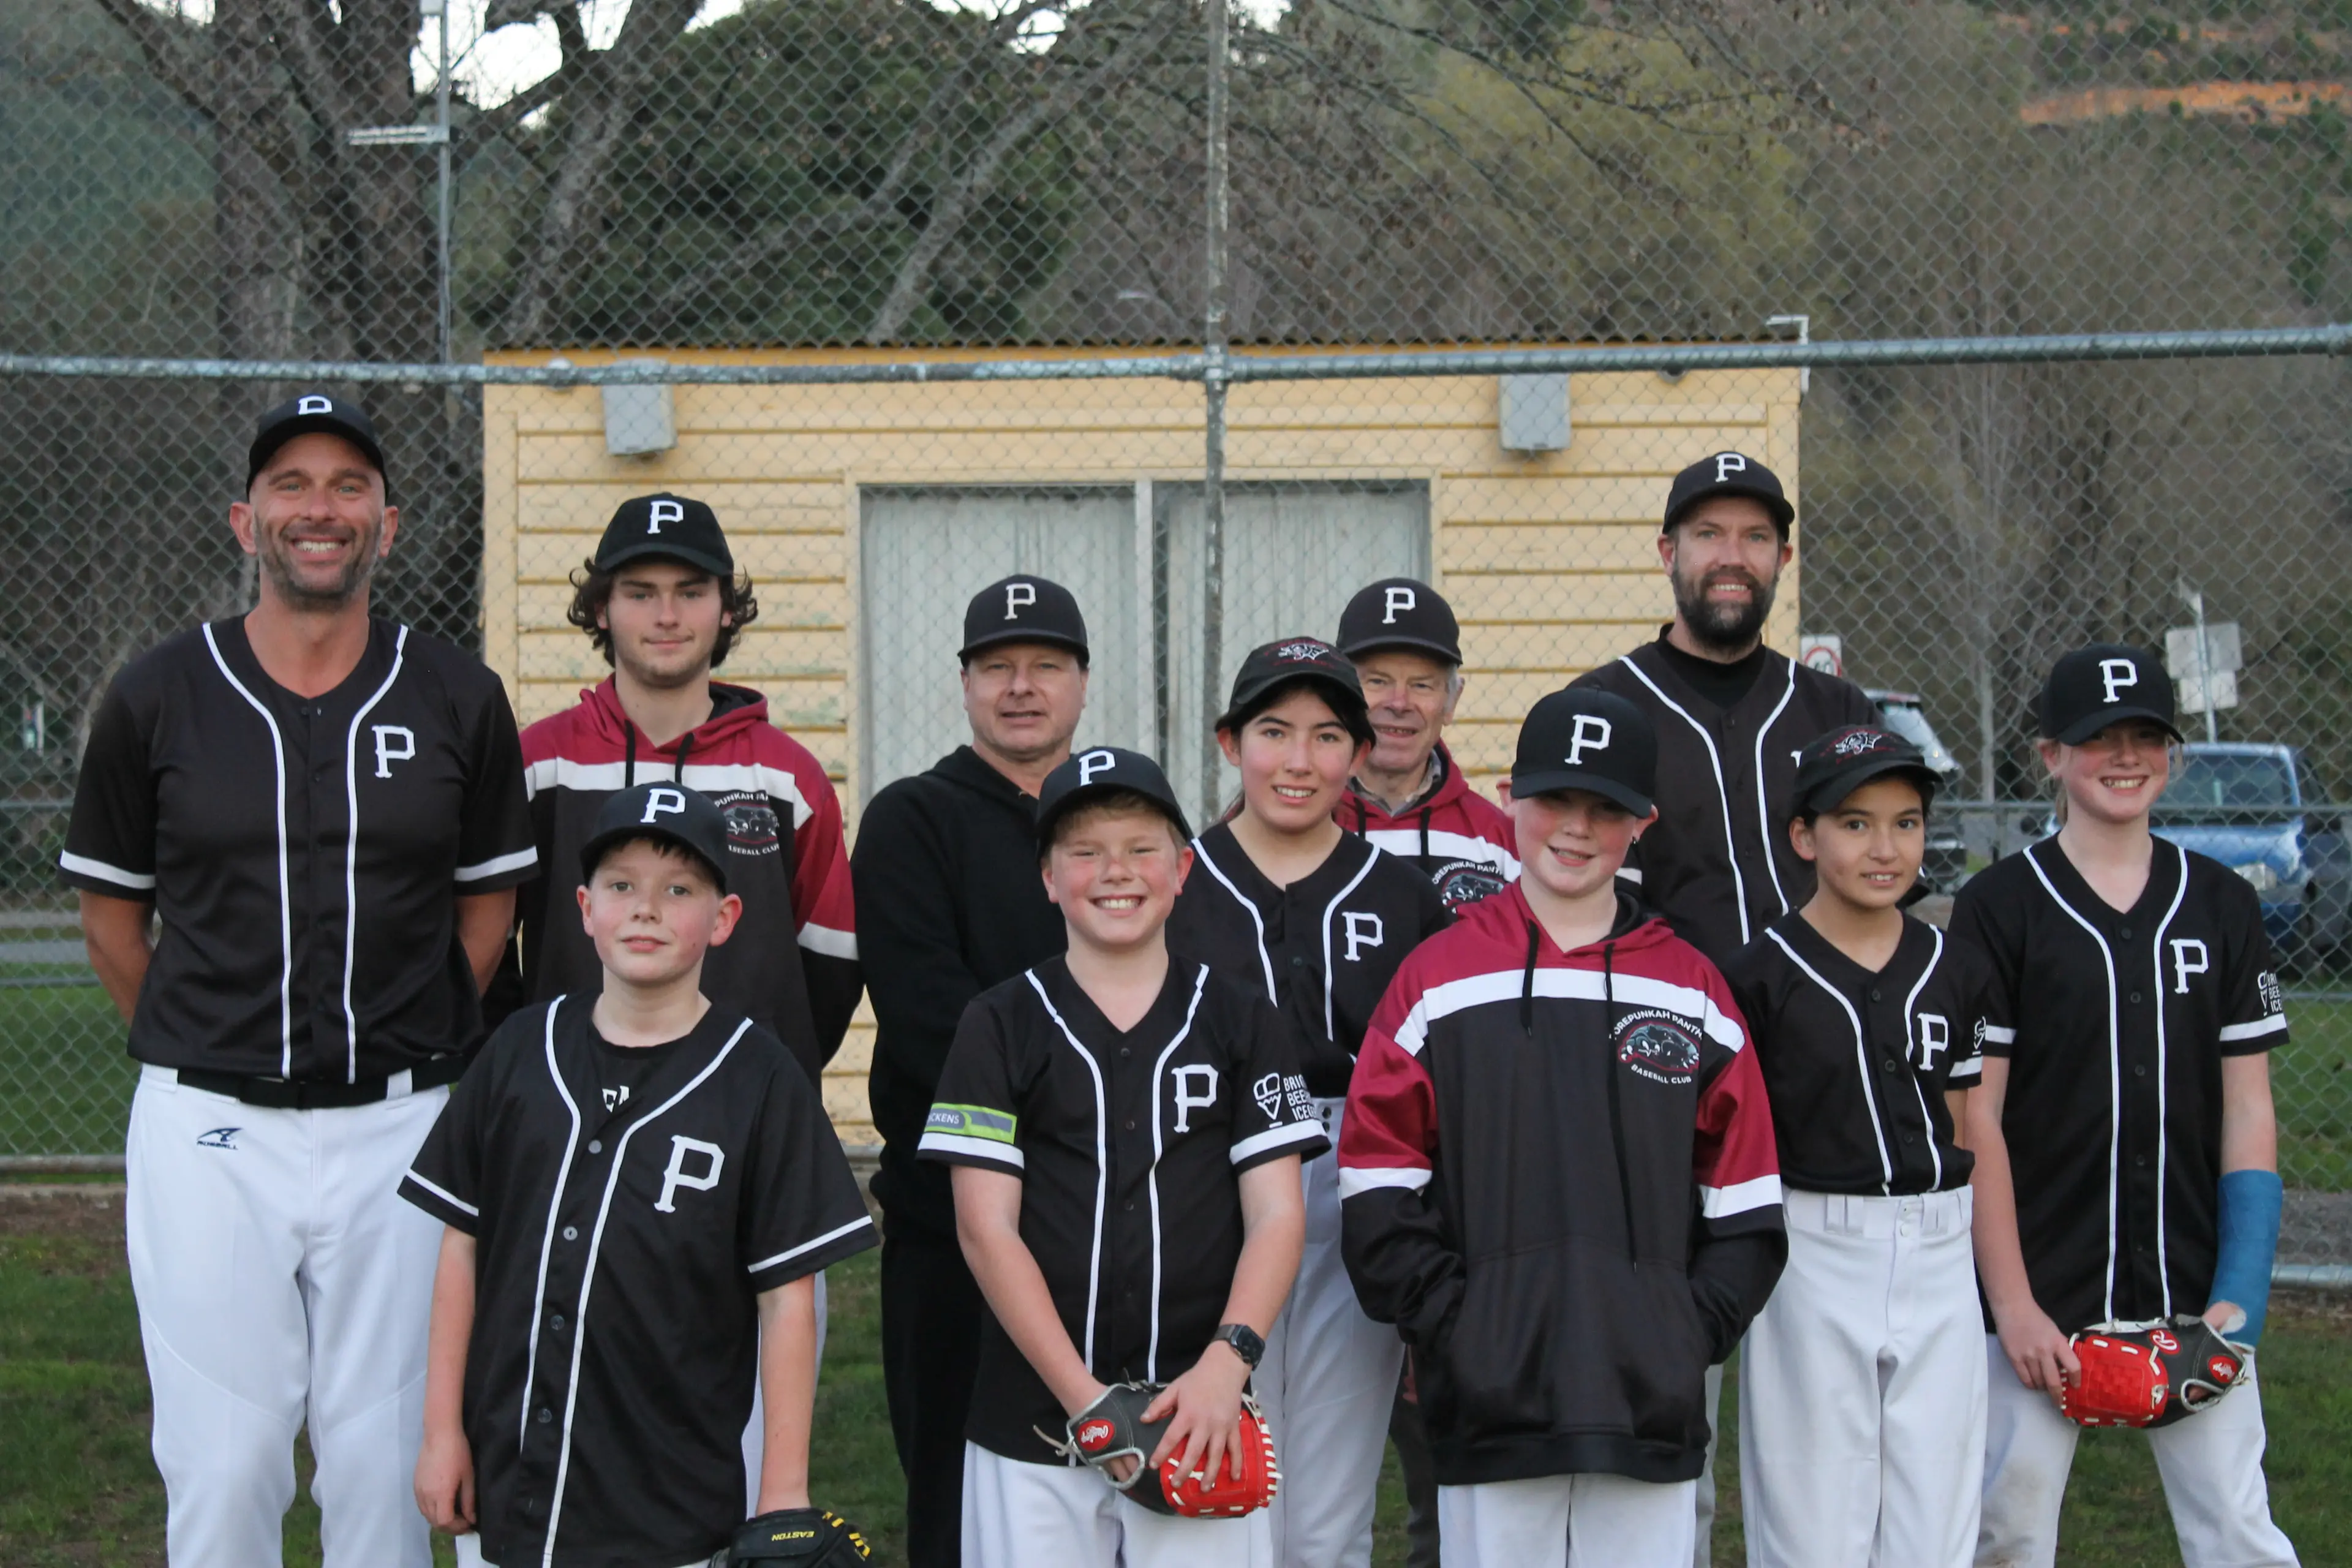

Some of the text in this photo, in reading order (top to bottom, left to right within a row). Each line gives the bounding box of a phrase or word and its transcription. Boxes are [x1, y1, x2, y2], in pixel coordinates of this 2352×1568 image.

[1715, 453, 1746, 483] P
[647, 500, 684, 534] P
[1005, 583, 1036, 620] P
[1382, 587, 1415, 624] P
[2098, 658, 2138, 703] P
[371, 725, 416, 778] P
[1564, 714, 1611, 765] P
[1078, 750, 1116, 786] P
[640, 788, 686, 823] P
[1431, 861, 1476, 885] OREPUNKAH
[1341, 911, 1384, 962] P
[2169, 938, 2209, 994] P
[1917, 1012, 1948, 1071] P
[1630, 1063, 1692, 1084] BASEBALL CLUB
[1170, 1064, 1219, 1133] P
[654, 1134, 725, 1213] P
[771, 1531, 815, 1542] EASTON
